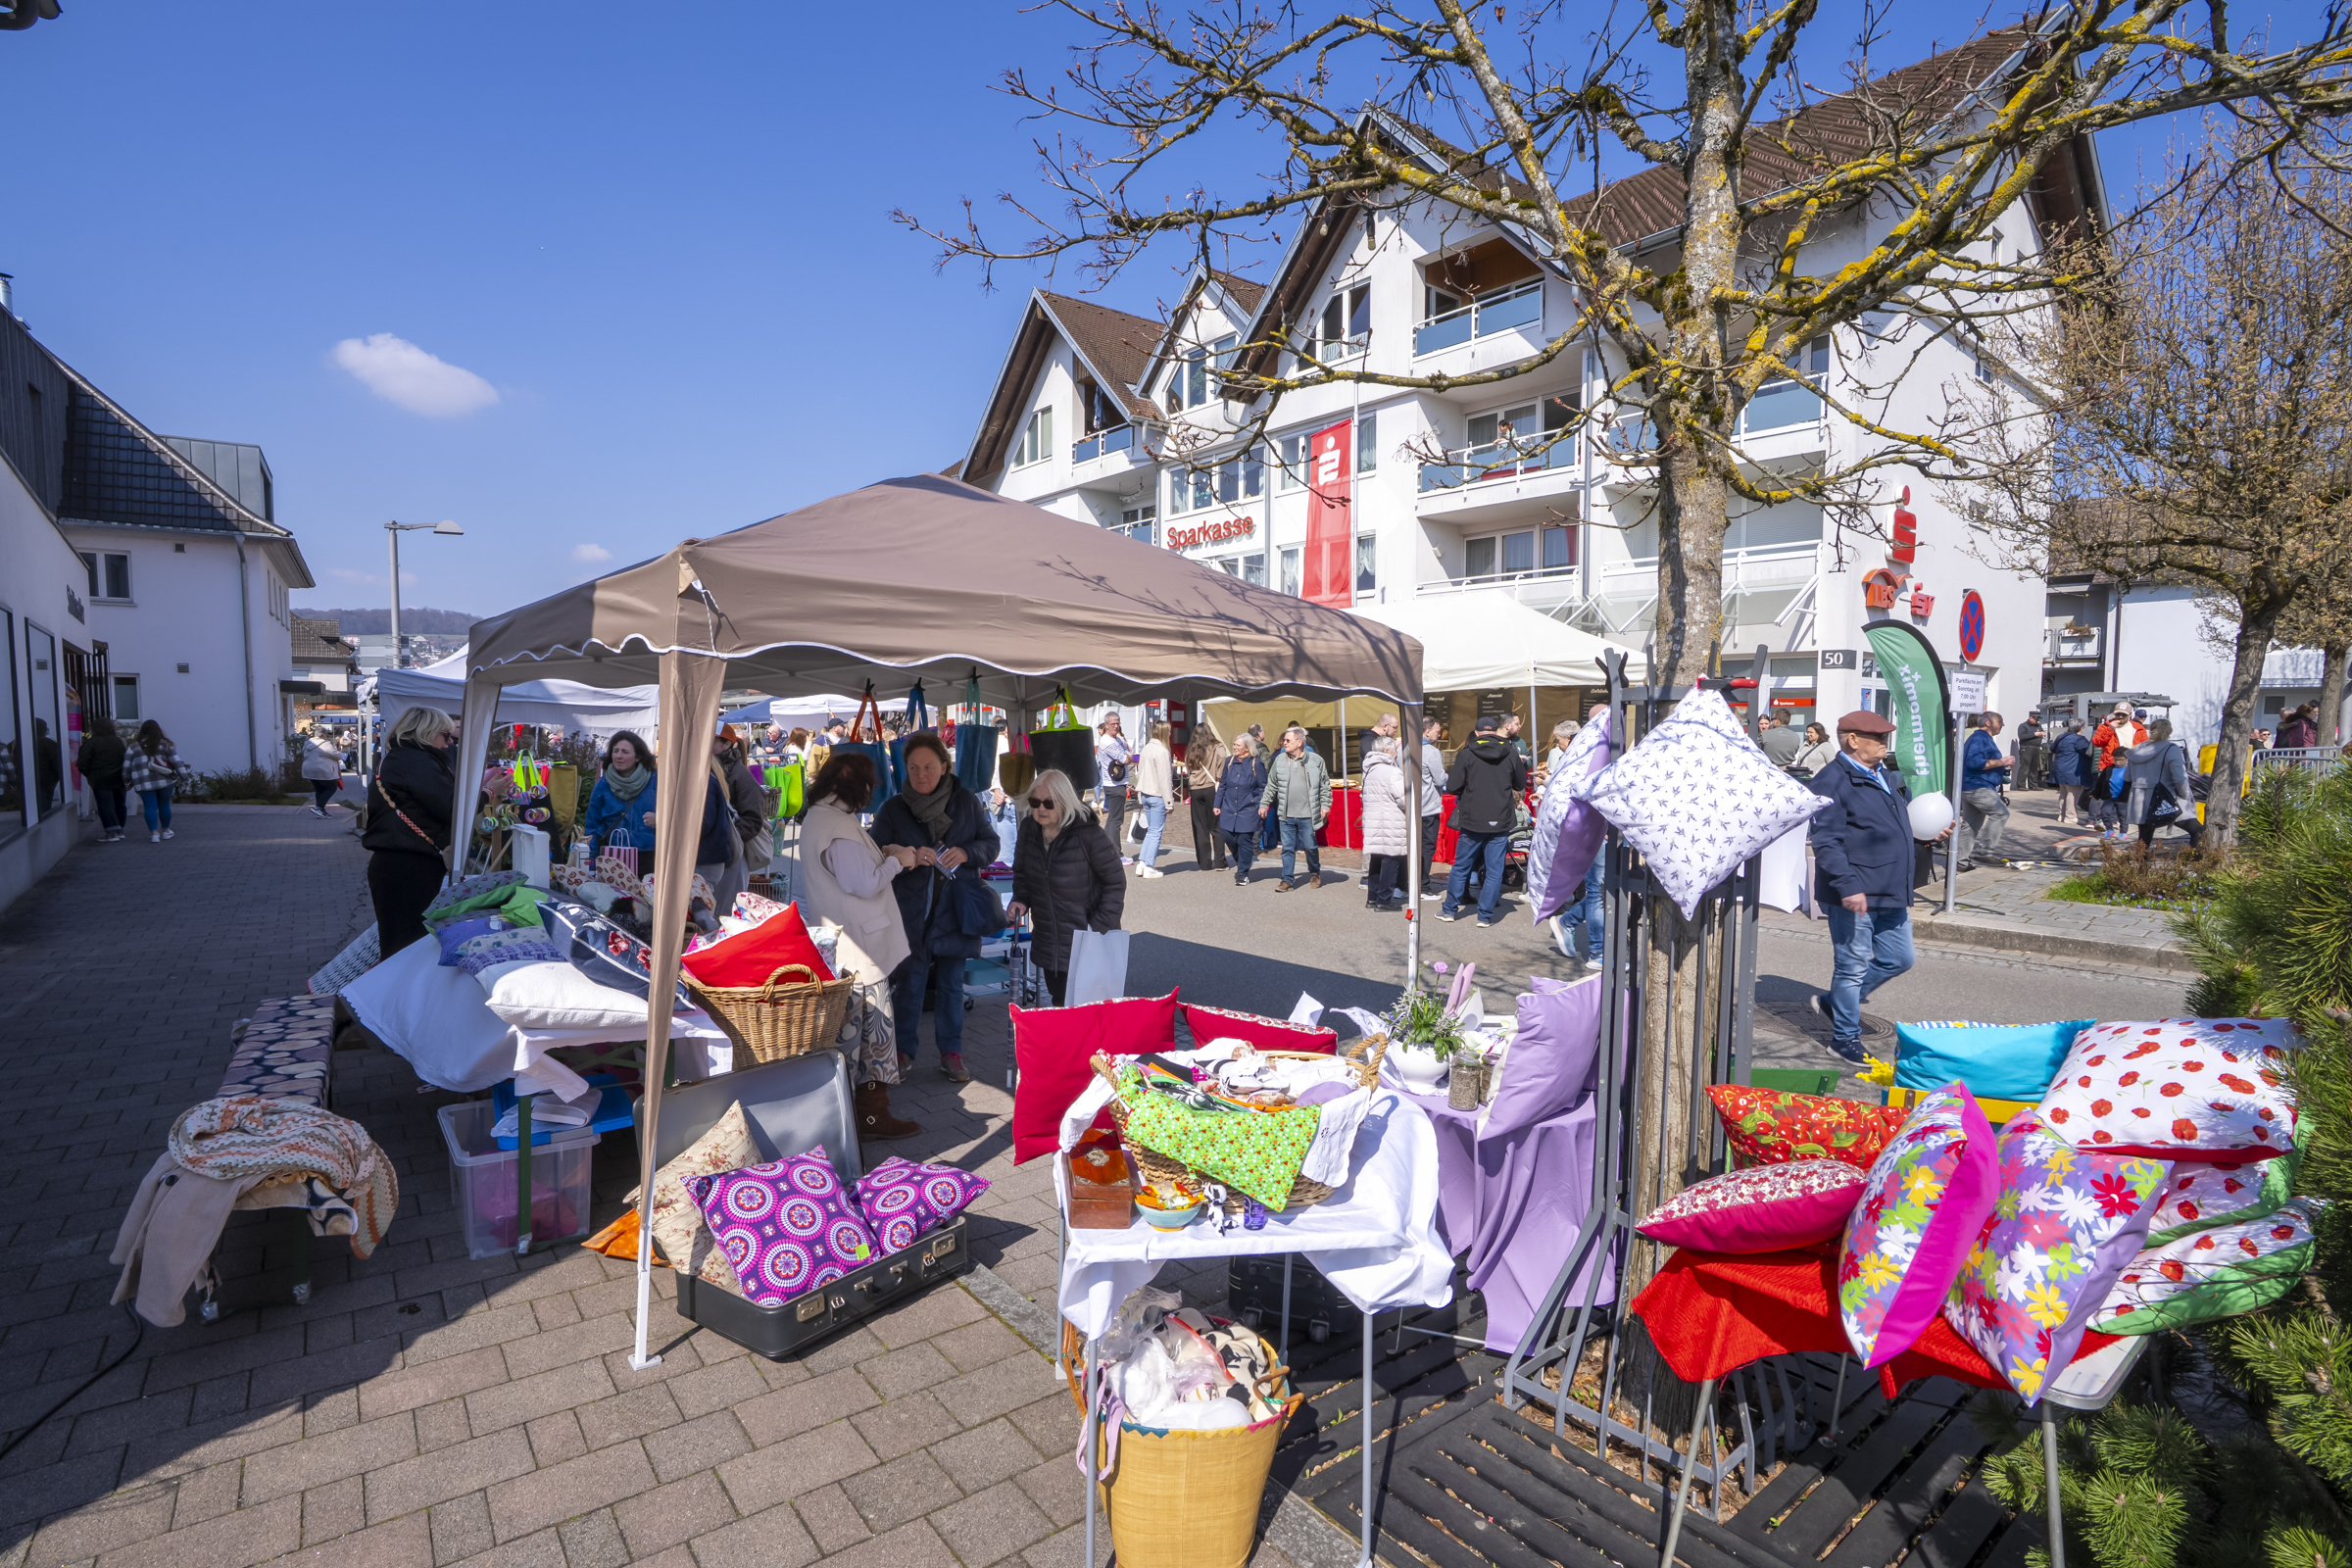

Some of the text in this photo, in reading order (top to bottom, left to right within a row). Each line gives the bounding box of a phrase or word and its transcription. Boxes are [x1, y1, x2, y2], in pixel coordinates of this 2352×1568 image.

[1167, 516, 1253, 551] Sparkasse
[1867, 582, 1895, 610] LBS
[1824, 652, 1843, 665] 50
